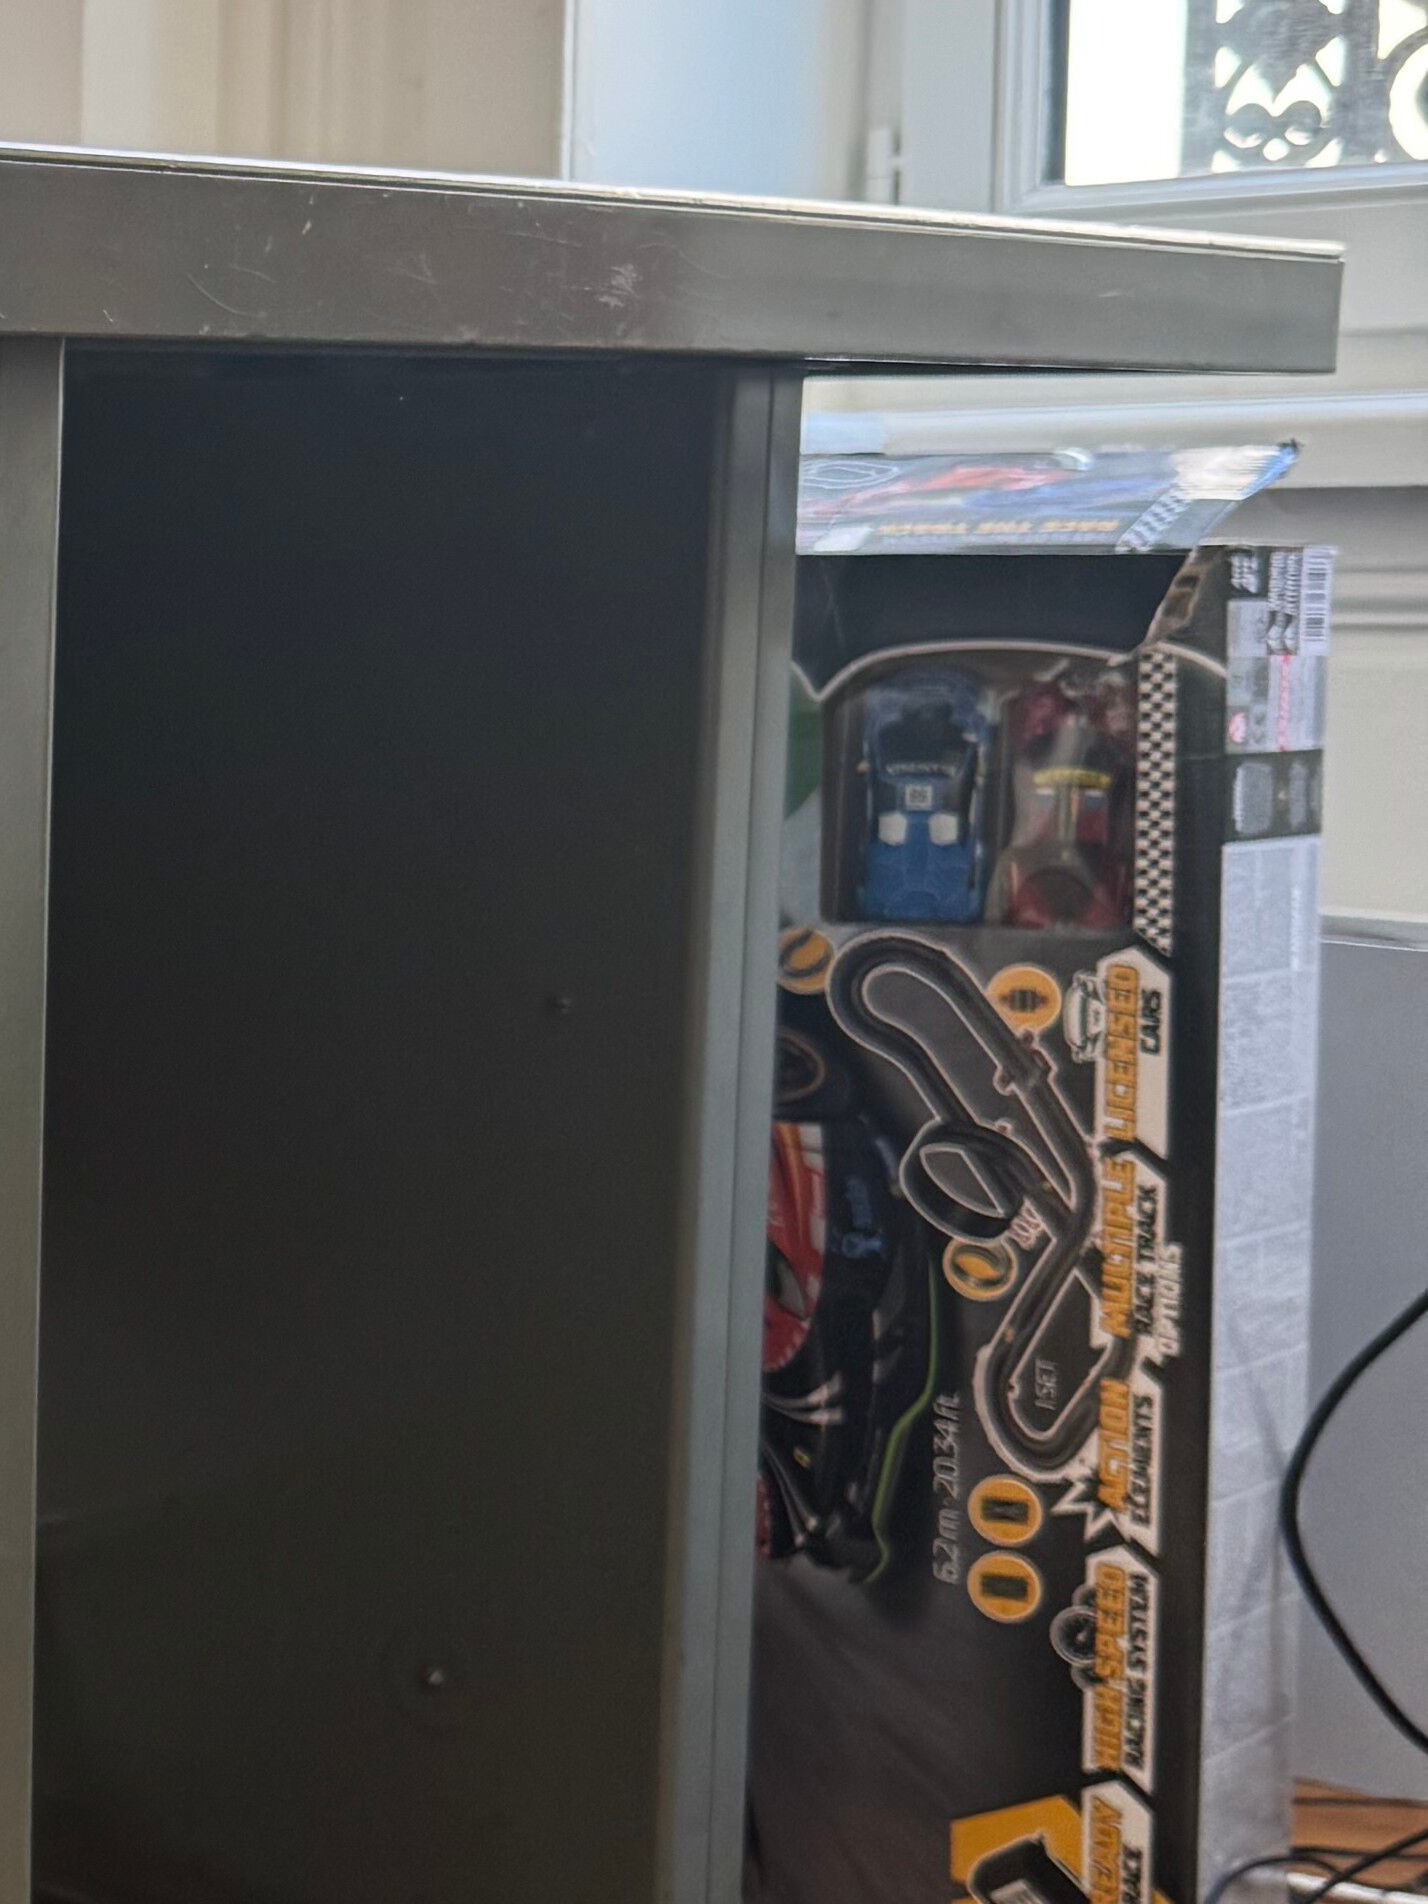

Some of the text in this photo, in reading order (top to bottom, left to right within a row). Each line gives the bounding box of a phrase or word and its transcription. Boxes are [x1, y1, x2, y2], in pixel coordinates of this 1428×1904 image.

[1104, 963, 1138, 1139] LICENSED
[1139, 987, 1162, 1055] CARS
[1099, 1156, 1134, 1339] MULTIPLE
[1132, 1182, 1157, 1336] RACE TRACK
[1157, 1241, 1182, 1355] OPTIONS
[1098, 1376, 1130, 1512] ACTION
[1129, 1392, 1152, 1527] ELEMENTS
[1092, 1560, 1125, 1770] HIGH SPEED
[1124, 1571, 1149, 1769] RACING SYSTEM
